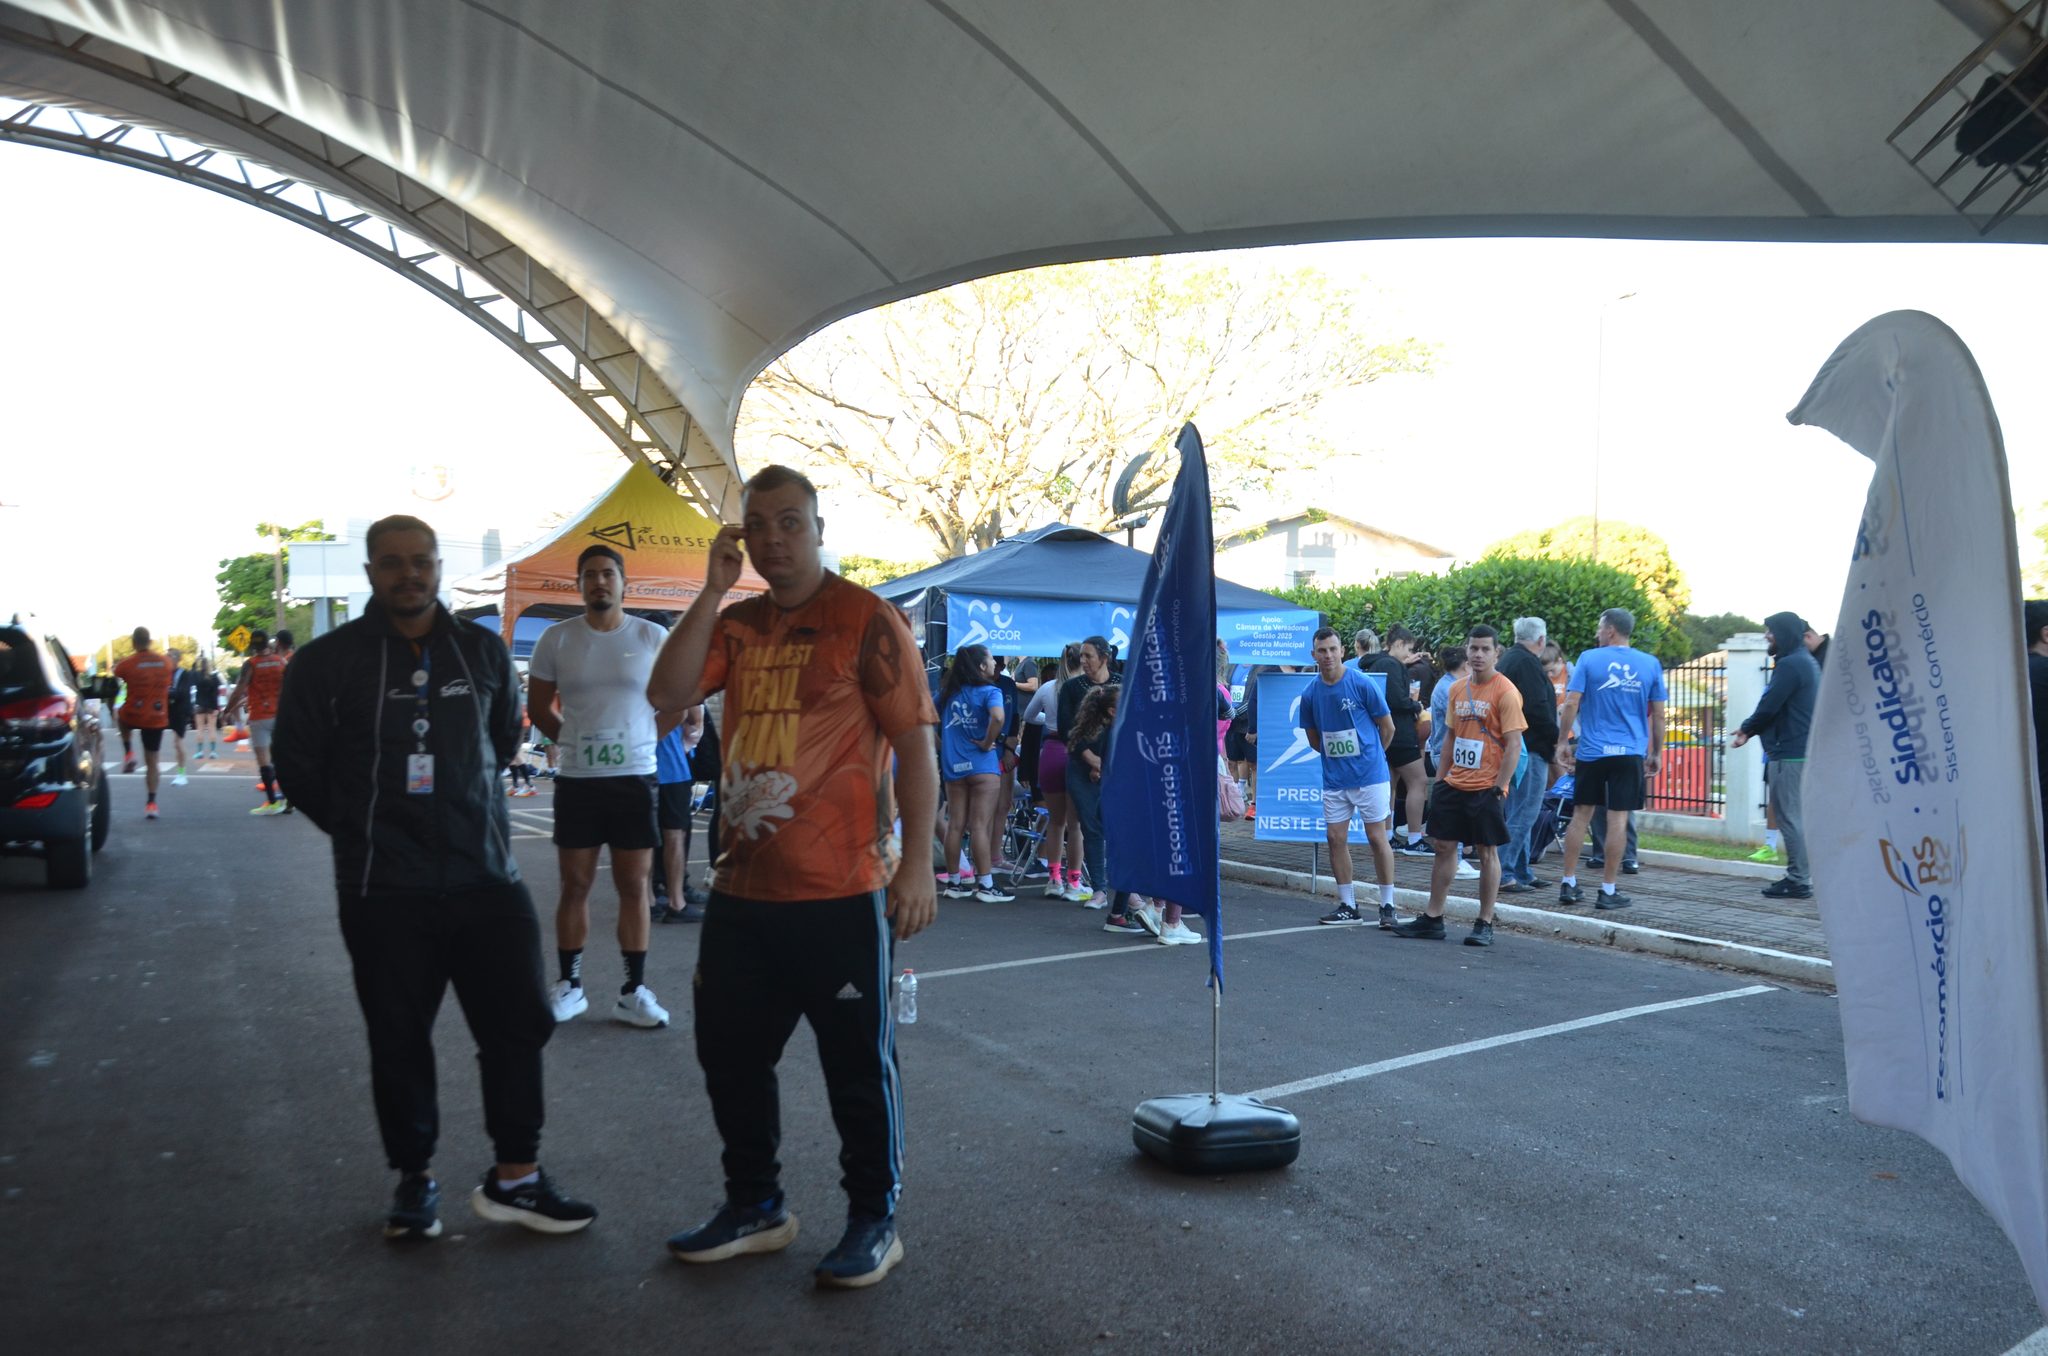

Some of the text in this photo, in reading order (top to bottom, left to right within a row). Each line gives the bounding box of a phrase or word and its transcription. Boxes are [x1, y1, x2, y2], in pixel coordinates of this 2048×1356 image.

[541, 579, 577, 591] Assoc
[1235, 623, 1309, 632] Câmara de Vereadores
[1261, 616, 1284, 624] Apoio:
[989, 629, 1021, 641] GCOR
[1253, 632, 1293, 640] Gestão 2025
[1239, 640, 1305, 649] Secretaria Municipal
[1144, 604, 1166, 702] Sindicatos
[1261, 649, 1291, 657] Esportes
[1177, 655, 1188, 704] Sistema
[1862, 609, 1920, 785] Sindicatos
[1935, 692, 1960, 783] Sistema
[583, 743, 625, 767] 143
[1328, 739, 1355, 755] 206
[1455, 747, 1476, 766] 619
[1156, 731, 1185, 876] Fecomércio RS
[1258, 816, 1311, 830] NESTE
[1912, 835, 1946, 1100] Fecomércio RS
